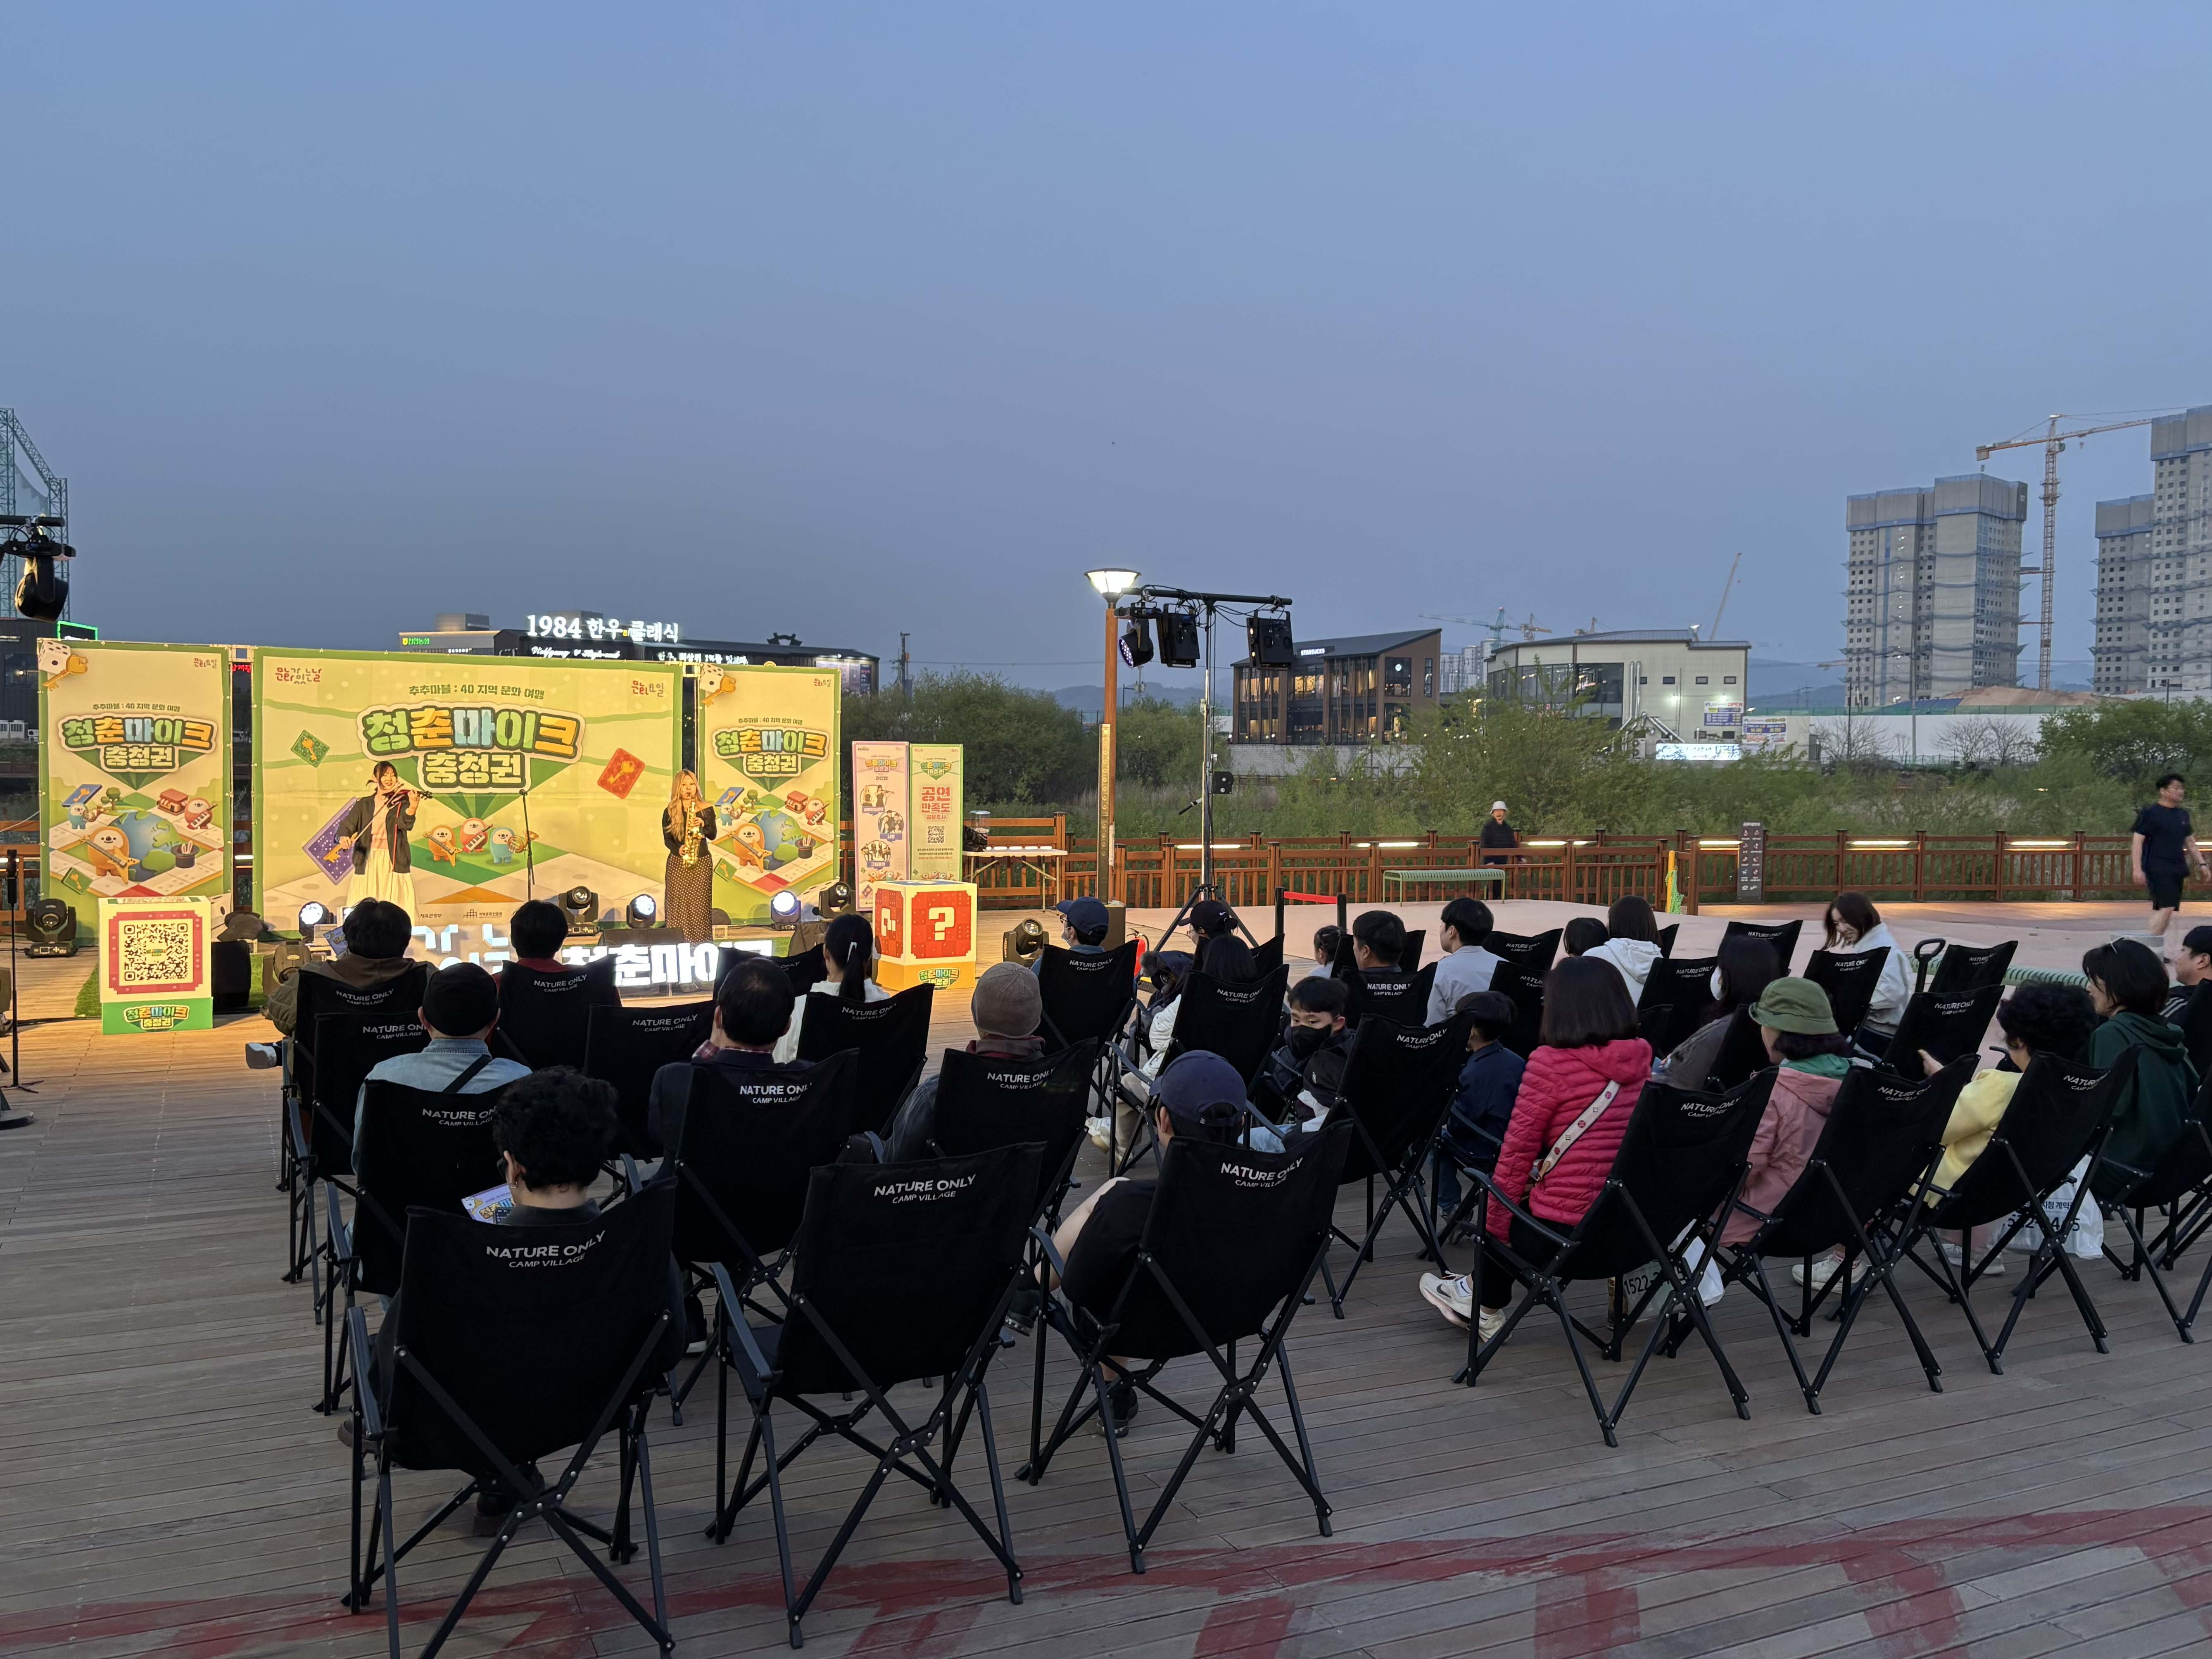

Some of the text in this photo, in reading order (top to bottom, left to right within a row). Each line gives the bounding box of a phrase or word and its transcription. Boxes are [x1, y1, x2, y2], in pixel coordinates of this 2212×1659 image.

[527, 615, 678, 643] 1984 한우 클래식
[409, 684, 451, 695] 추추마블
[461, 685, 474, 694] 40
[477, 685, 498, 696] 지역
[501, 686, 521, 697] 문화
[63, 717, 211, 749] 청춘마이크
[366, 708, 577, 755] 청춘마이크
[716, 729, 826, 756] 청춘마이크
[105, 745, 173, 767] 충청권
[747, 754, 797, 772] 충청권
[426, 753, 522, 784] 충청권
[922, 787, 950, 801] 공연
[922, 803, 950, 813] 만족도
[534, 974, 587, 988] NATURE ONLY
[919, 969, 959, 980] 청춘마이크
[336, 989, 394, 1001] NATURE ONLY
[1217, 989, 1247, 998] NATURE
[126, 1006, 188, 1020] 청춘마이크
[842, 1006, 877, 1016] NATURE
[674, 1014, 698, 1024] ONLY
[363, 1024, 405, 1033] NATURE
[1397, 1028, 1447, 1044] NATURE ONLY
[987, 1072, 1030, 1083] NATURE
[740, 1086, 784, 1095] NATURE
[422, 1108, 475, 1119] NATURE
[1221, 1163, 1275, 1180] NATURE
[874, 1174, 976, 1197] NATURE ONLY
[2055, 1200, 2073, 1210] 계약
[486, 1230, 606, 1258] NATURE ONLY
